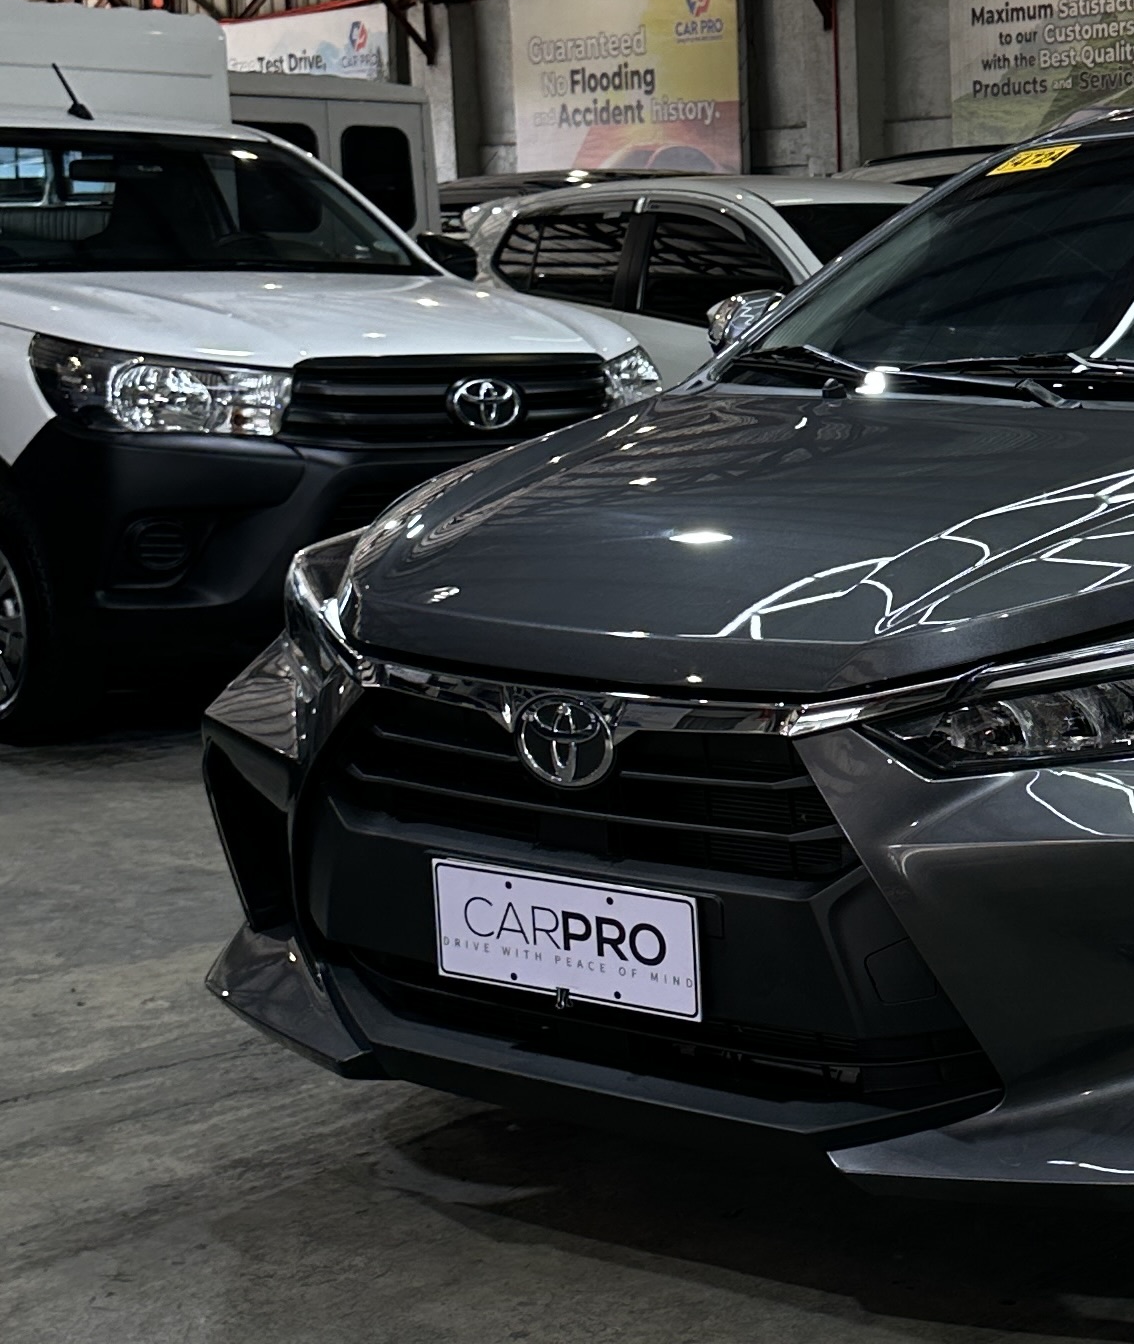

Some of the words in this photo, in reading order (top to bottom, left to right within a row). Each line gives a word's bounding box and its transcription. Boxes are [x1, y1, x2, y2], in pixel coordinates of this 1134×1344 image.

[675, 20, 698, 37] CAR
[700, 18, 723, 34] PRO
[971, 1, 1053, 27] Maximum
[527, 25, 647, 64] Guaranteed
[999, 30, 1013, 46] to
[1016, 31, 1037, 45] our
[981, 52, 1011, 71] with
[1014, 50, 1037, 68] the
[1039, 46, 1077, 69] Best
[541, 71, 568, 97] No
[570, 62, 656, 95] Flooding
[972, 75, 1048, 99] Products
[1053, 76, 1072, 90] and
[557, 99, 644, 128] Accident
[650, 95, 721, 126] history.
[464, 896, 667, 966] CARPRO
[443, 936, 491, 953] DRIVE
[502, 946, 543, 961] WITH
[555, 955, 606, 973] PEACE
[618, 967, 638, 978] OF
[650, 972, 693, 988] MIND
